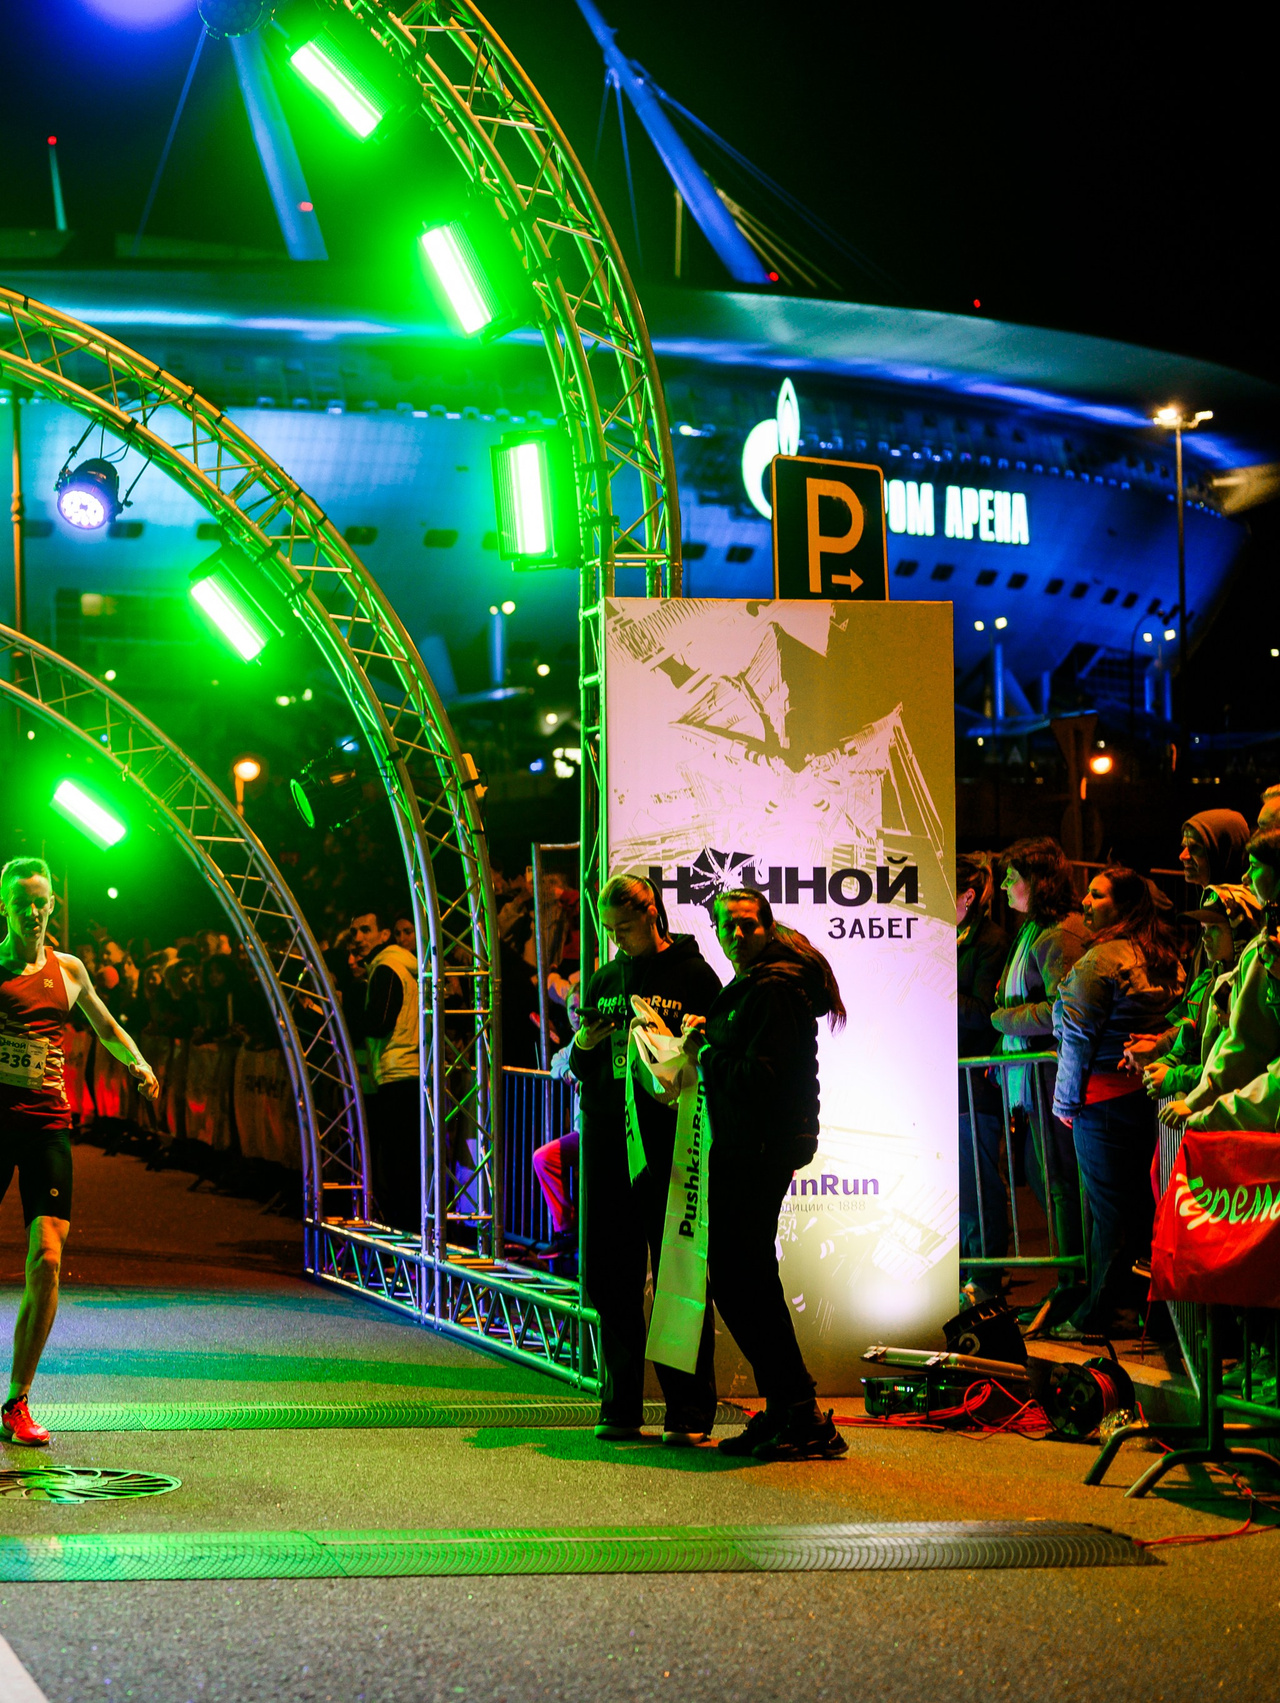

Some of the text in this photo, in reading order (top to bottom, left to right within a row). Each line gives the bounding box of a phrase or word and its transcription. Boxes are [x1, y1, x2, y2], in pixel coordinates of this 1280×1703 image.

[806, 477, 865, 593] P
[944, 485, 1030, 546] АРЕНА
[827, 917, 920, 940] ЗАБЕГ
[678, 1080, 707, 1239] PushkinRun
[786, 1170, 880, 1197] inRun
